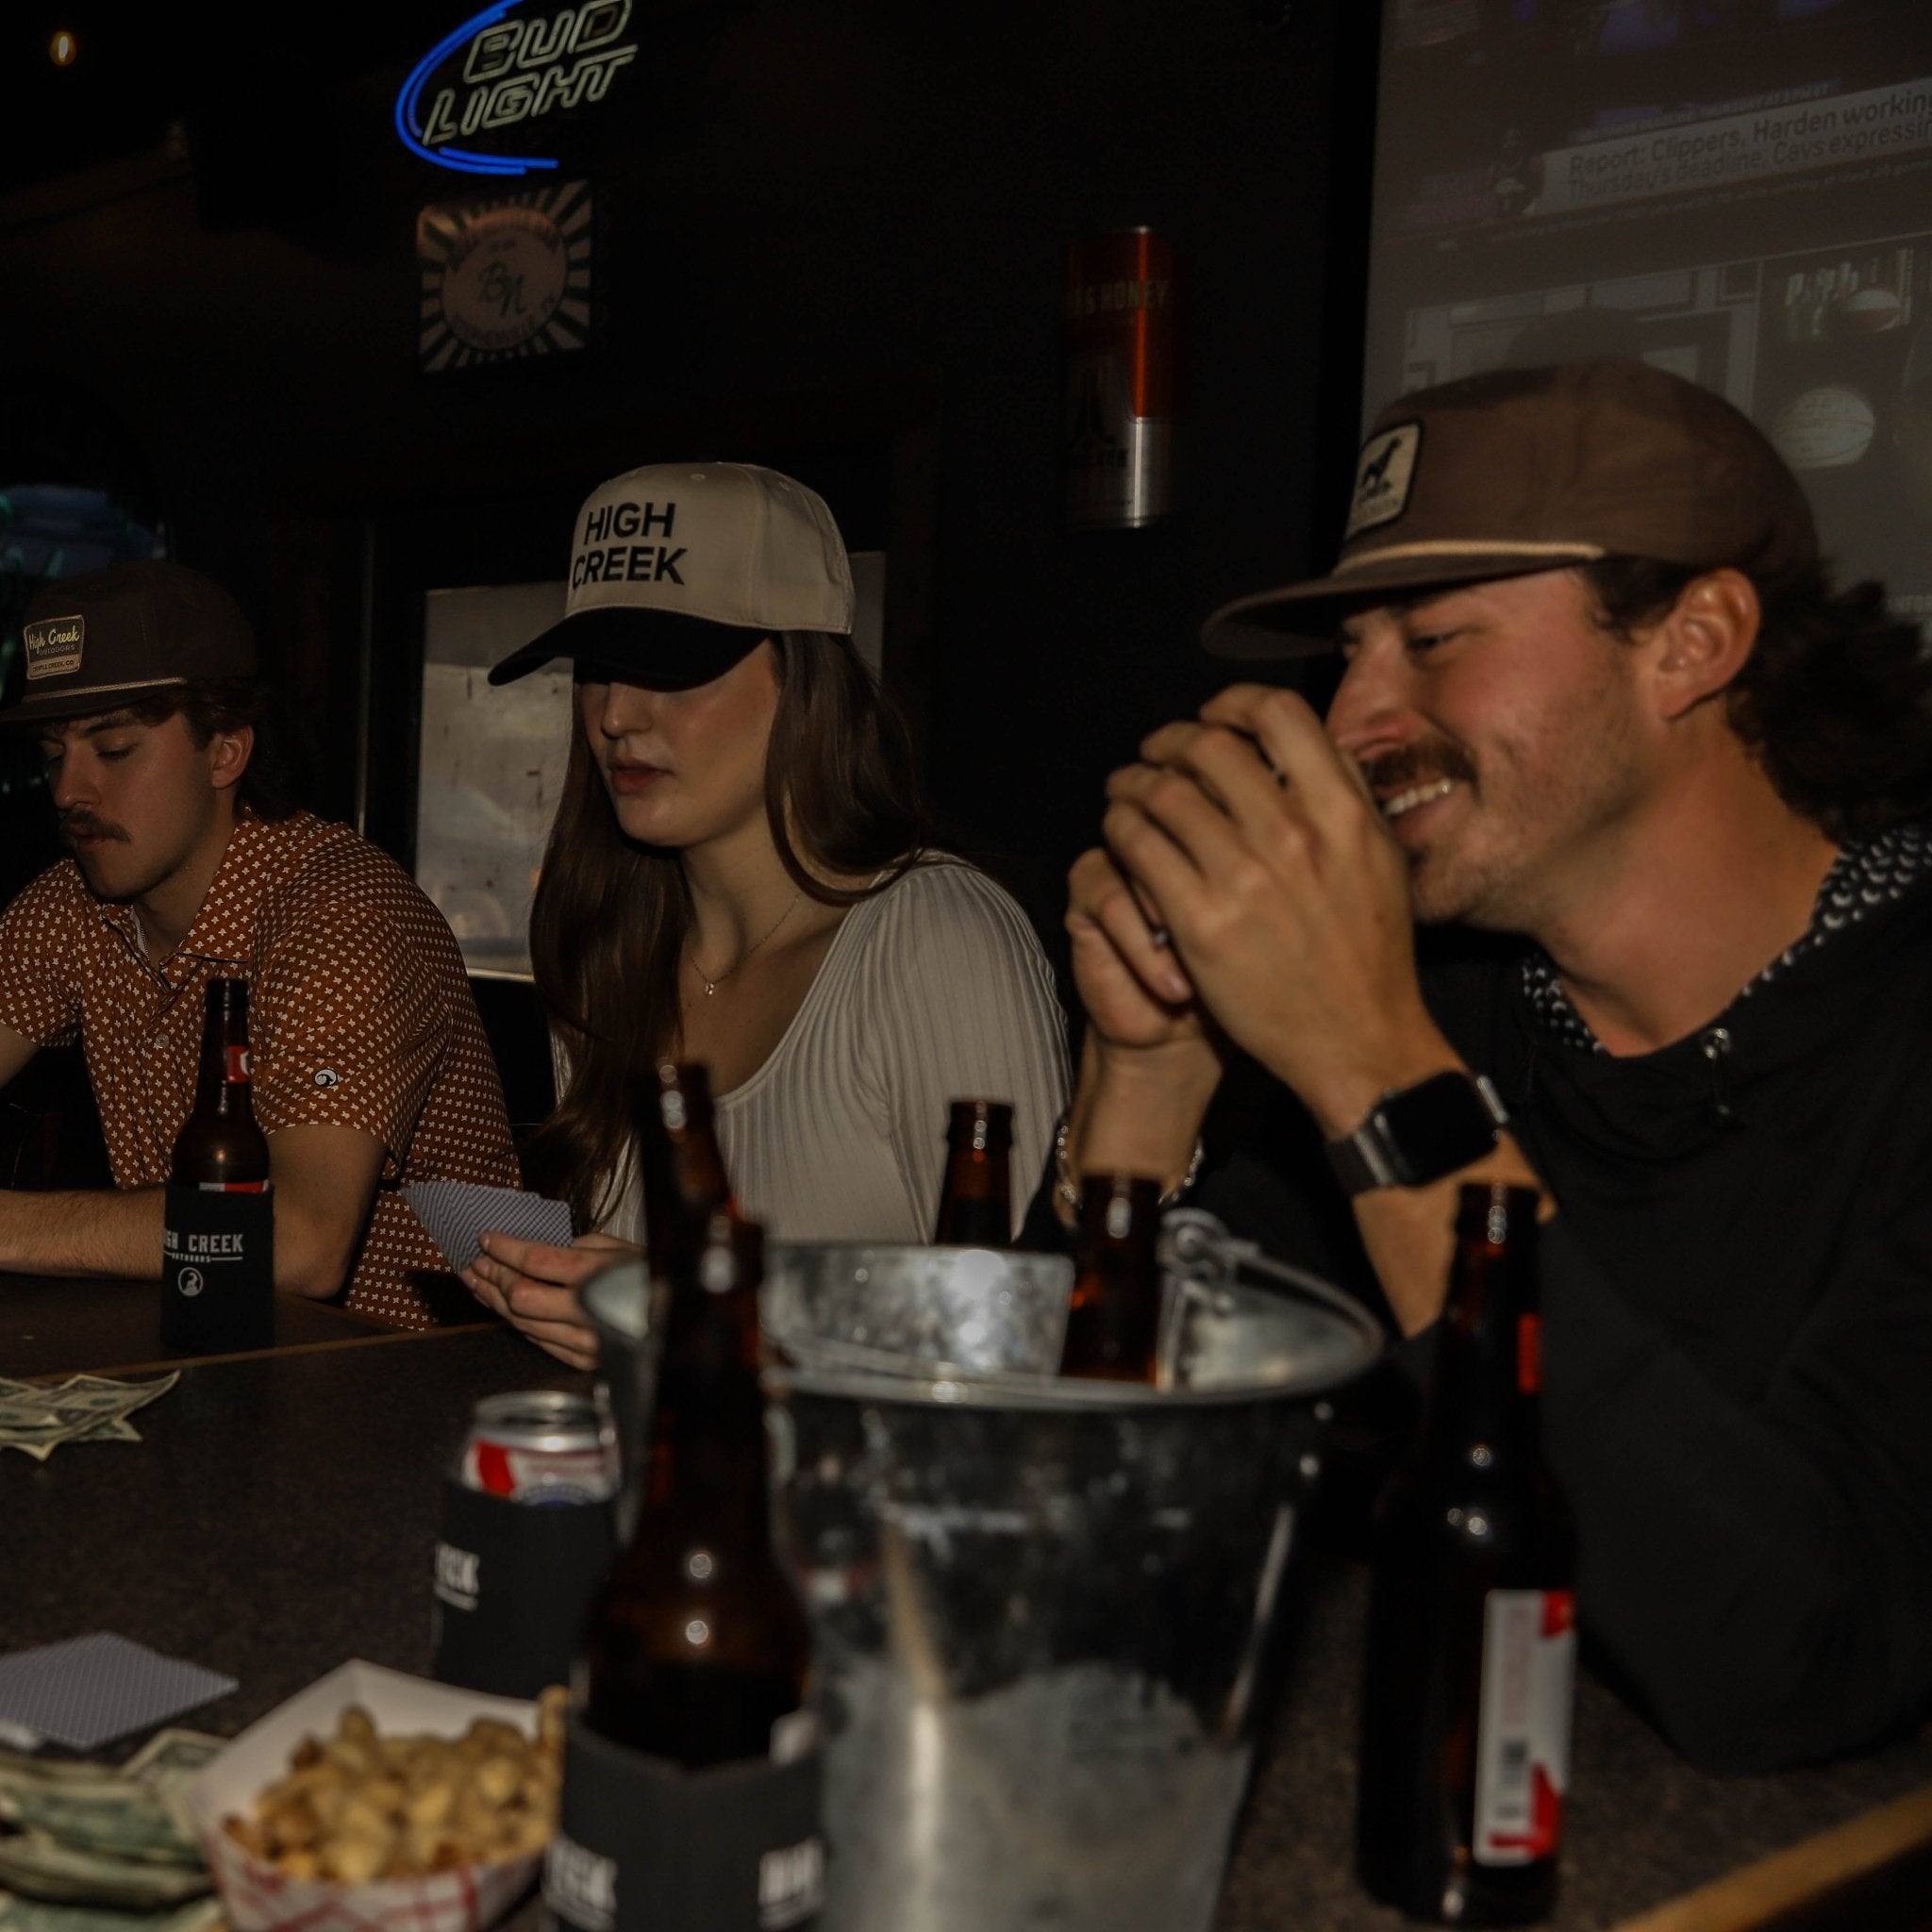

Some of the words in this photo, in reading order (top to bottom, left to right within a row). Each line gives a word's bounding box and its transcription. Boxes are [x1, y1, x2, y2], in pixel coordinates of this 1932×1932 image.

[463, 0, 632, 85] BUD
[422, 43, 639, 146] LIGHT
[1569, 147, 1645, 178] Report:
[1753, 109, 1837, 142] Harden
[1773, 133, 1824, 166] Cavs
[584, 502, 675, 545] HIGH
[572, 545, 687, 591] CREEK
[28, 630, 46, 655] High
[48, 625, 80, 645] Creek
[189, 1233, 243, 1253] CREEK
